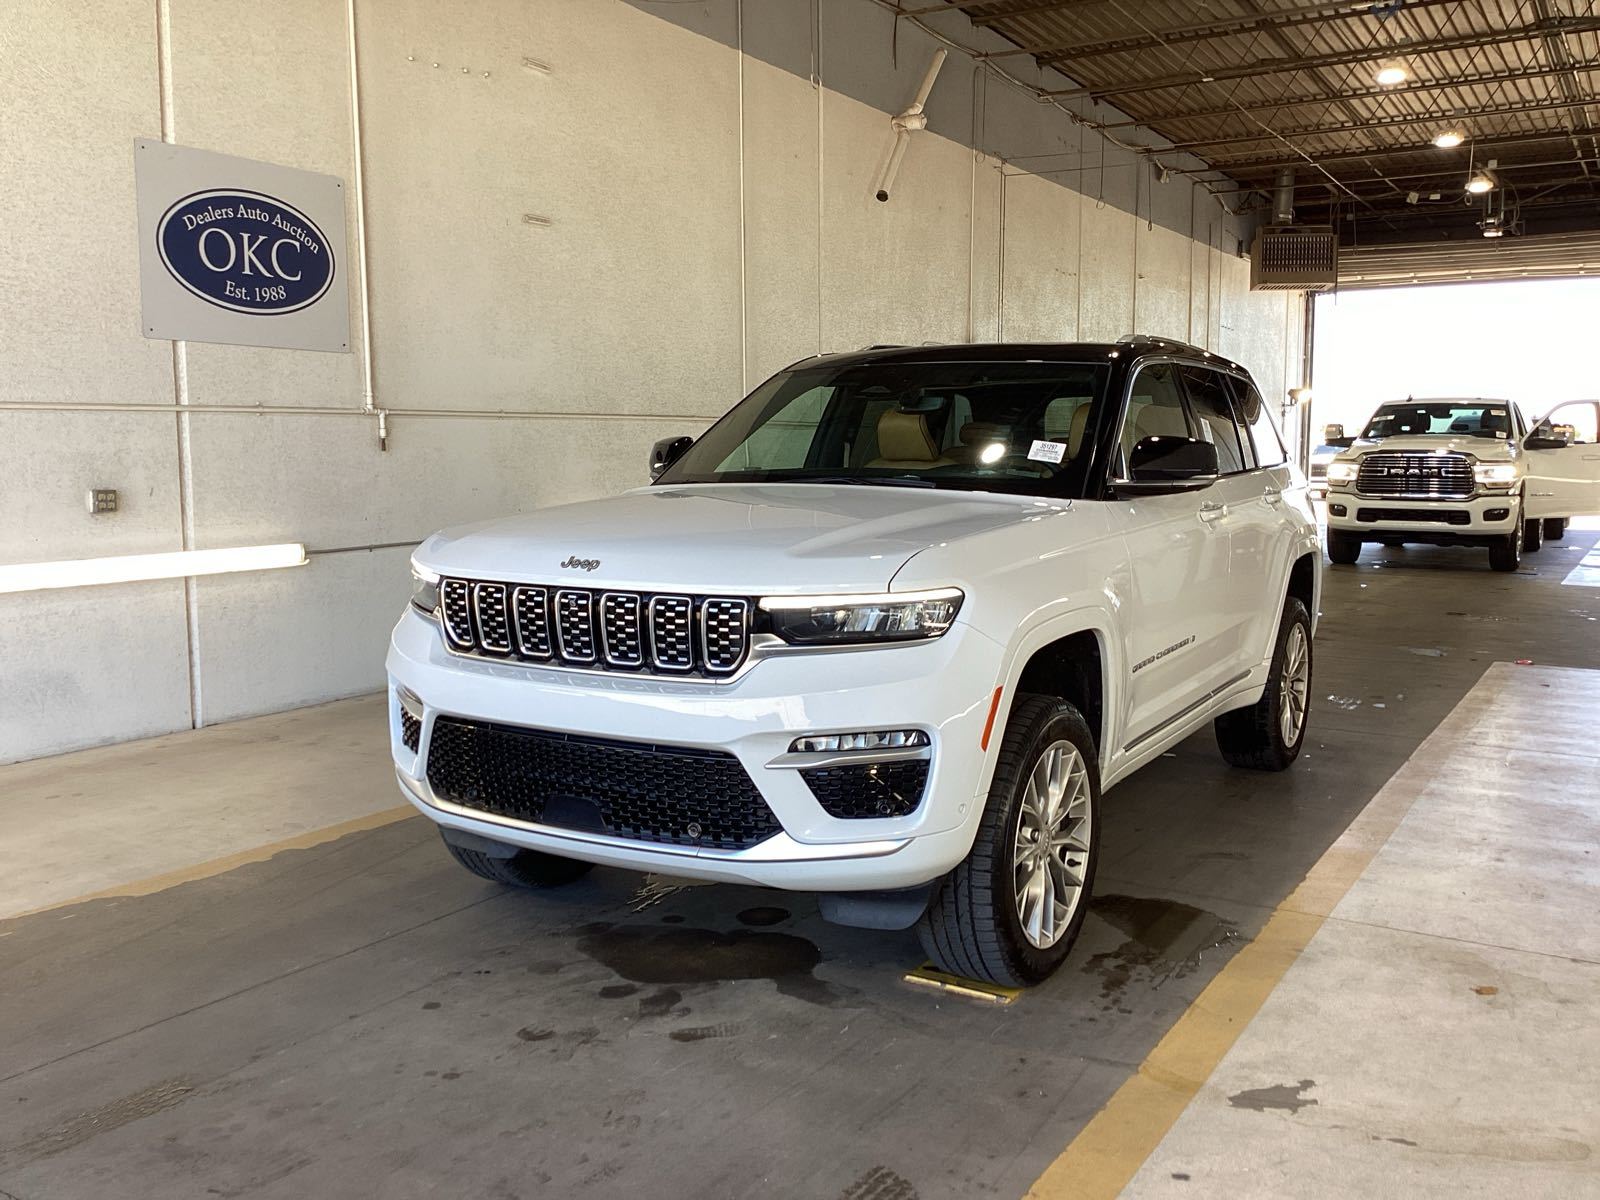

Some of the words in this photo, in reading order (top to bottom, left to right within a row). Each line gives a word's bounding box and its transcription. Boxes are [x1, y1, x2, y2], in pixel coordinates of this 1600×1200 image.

[182, 206, 234, 231] Dealers
[237, 204, 270, 222] Auto
[271, 213, 320, 254] Auction
[198, 227, 302, 281] OKC
[224, 280, 250, 301] Est.
[254, 285, 287, 303] 1988
[1390, 468, 1438, 476] RAM
[560, 555, 600, 572] Jeep
